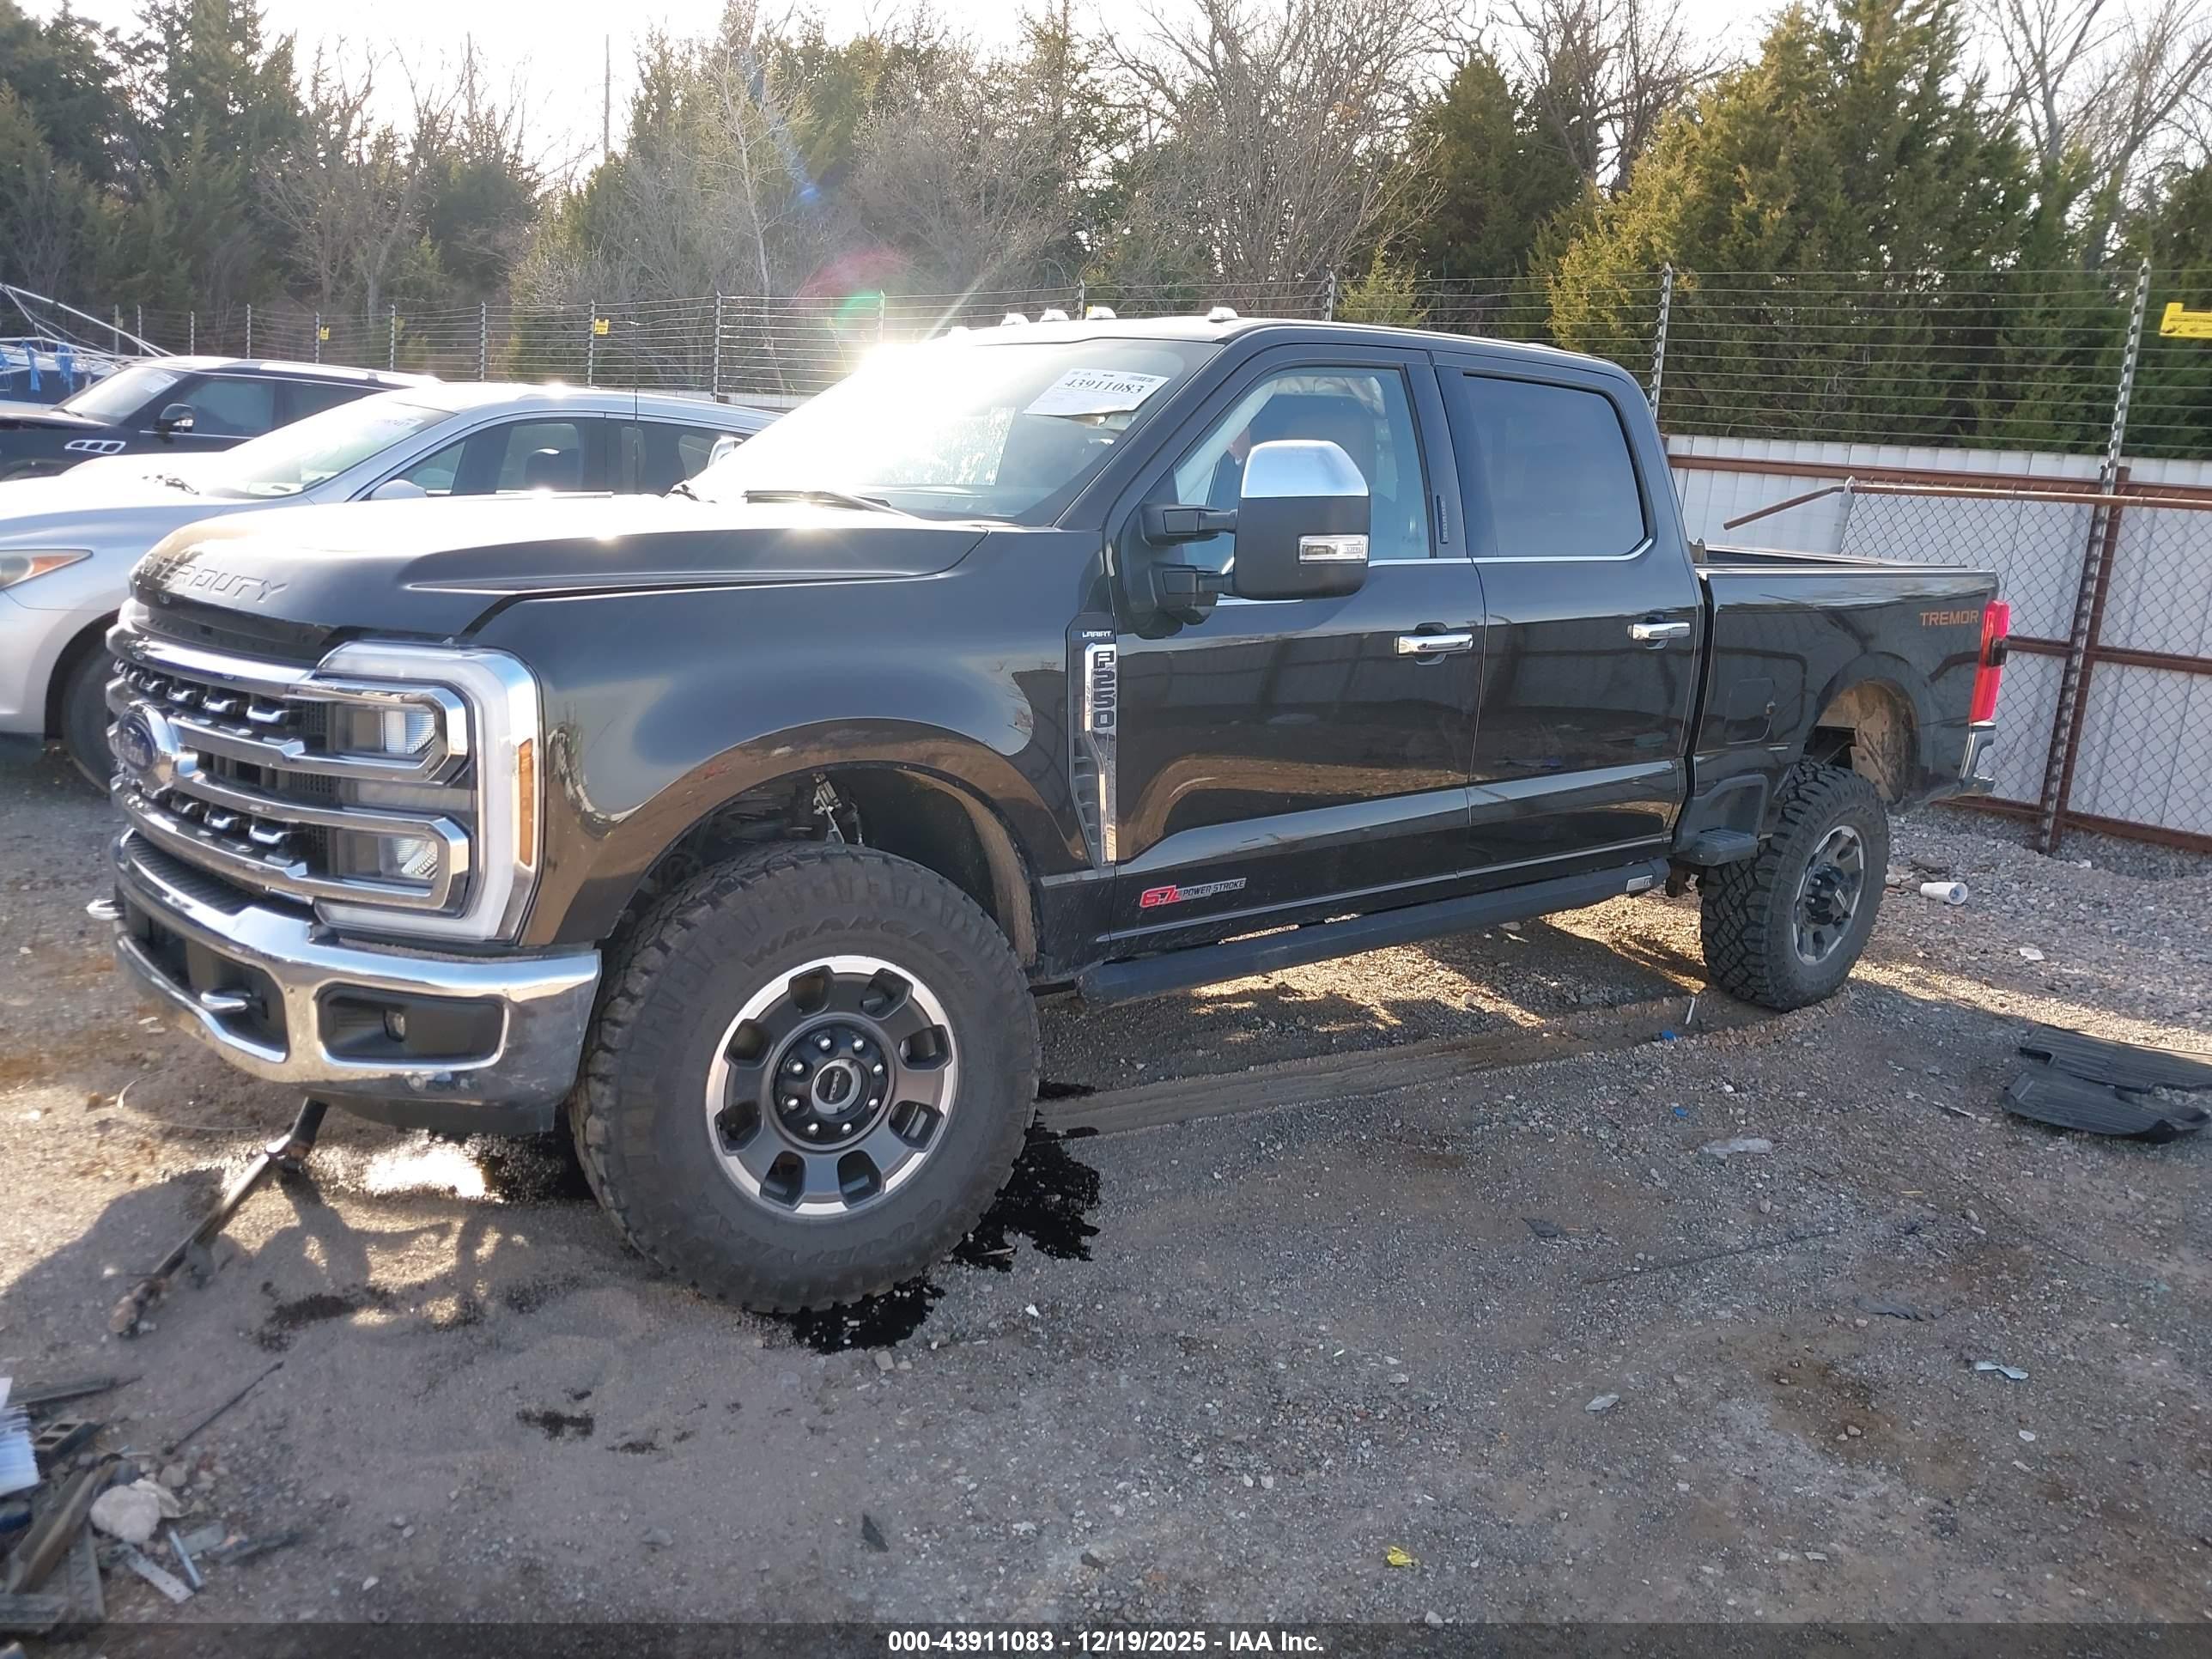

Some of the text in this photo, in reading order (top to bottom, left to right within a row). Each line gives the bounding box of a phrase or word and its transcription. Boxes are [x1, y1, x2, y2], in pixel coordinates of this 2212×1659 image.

[1065, 378, 1145, 394] 43911083
[189, 568, 289, 603] DUTY
[1919, 610, 1979, 626] TREMOR
[1182, 885, 1212, 896] POWER
[1212, 879, 1245, 892] STROKE
